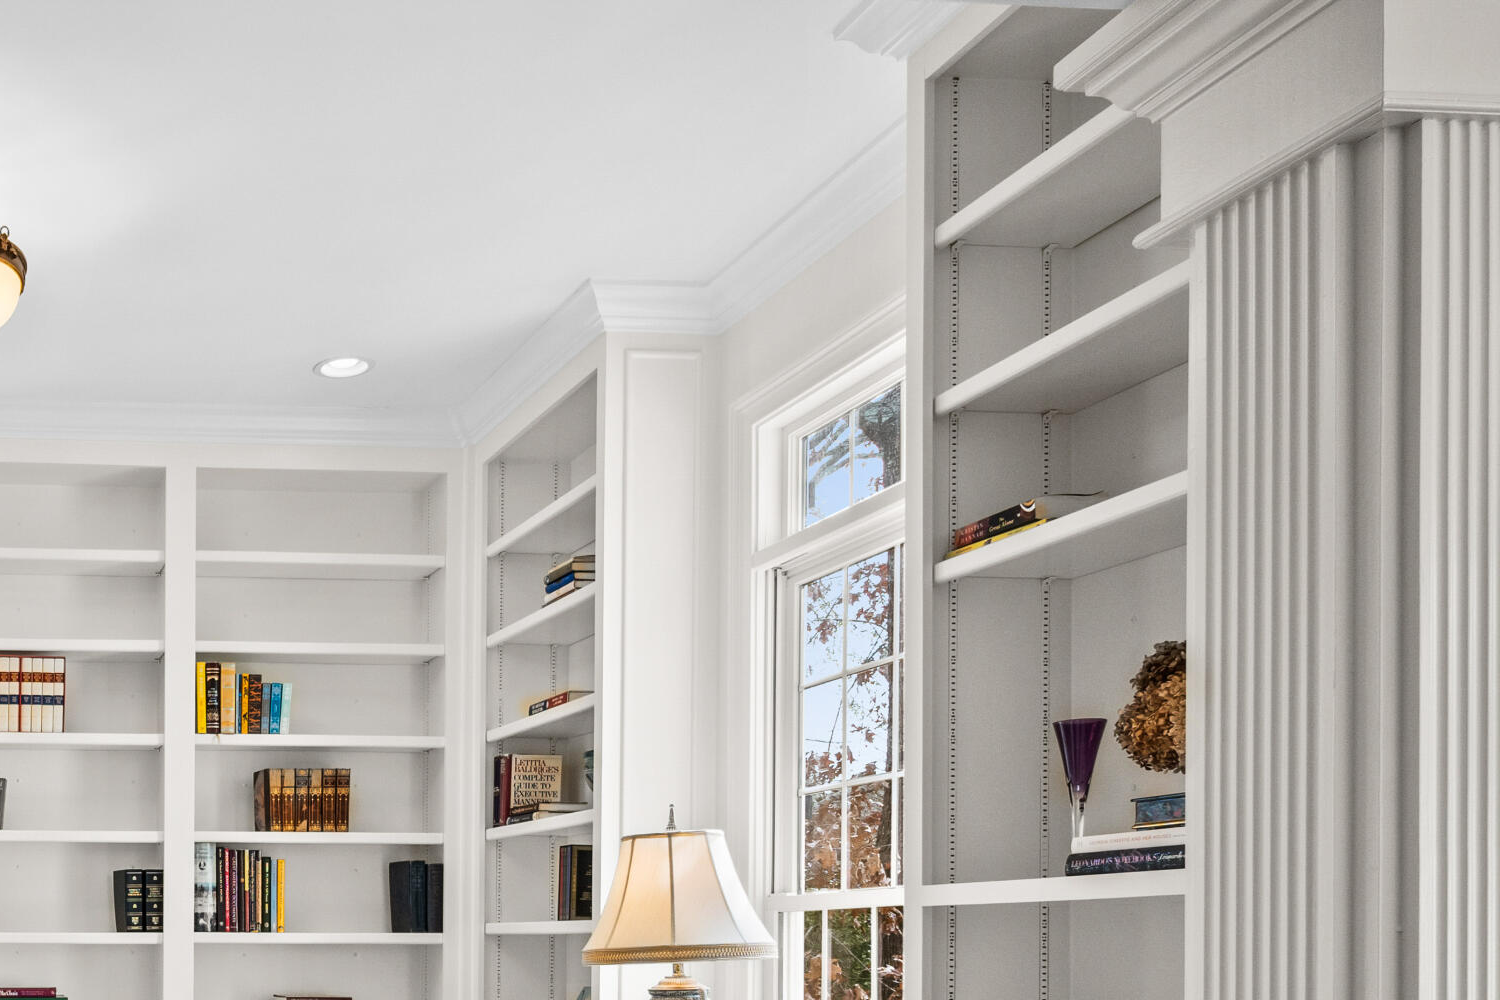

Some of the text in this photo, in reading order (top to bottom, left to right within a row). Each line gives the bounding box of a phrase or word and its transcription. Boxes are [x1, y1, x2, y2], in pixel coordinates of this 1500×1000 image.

[514, 757, 546, 767] LETITIA
[513, 774, 556, 782] COMPLETE
[513, 782, 551, 792] GUIDE TO
[513, 790, 558, 798] EXECUTIVE
